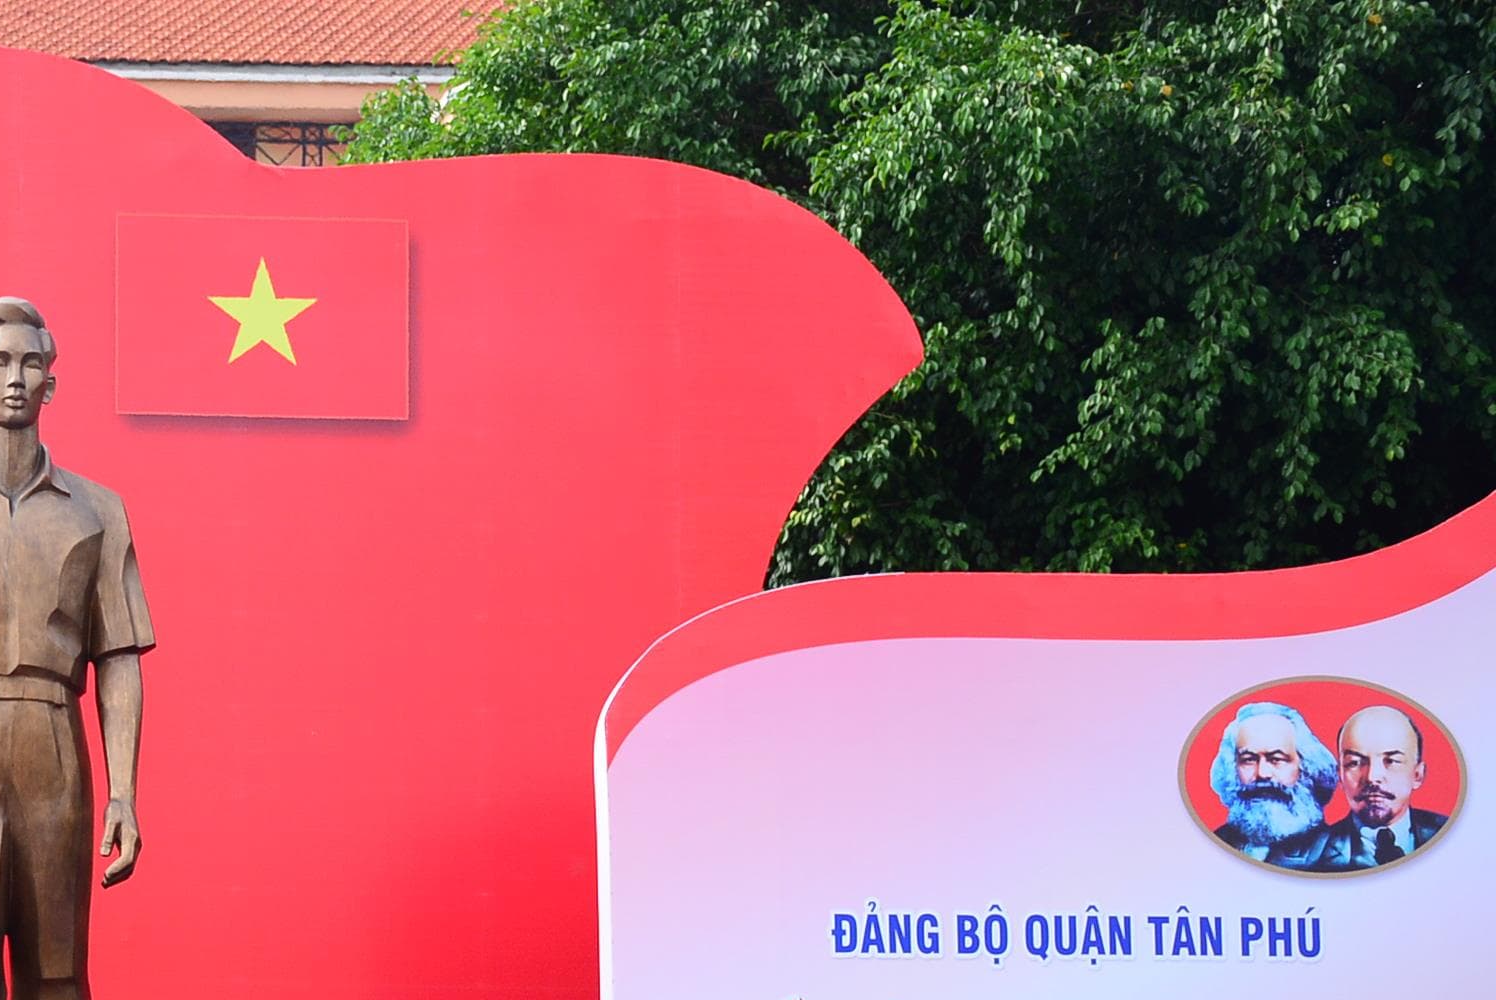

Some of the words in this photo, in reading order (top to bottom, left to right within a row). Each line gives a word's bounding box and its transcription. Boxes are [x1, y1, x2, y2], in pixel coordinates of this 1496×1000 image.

[832, 900, 940, 955] ĐẢNG
[956, 905, 1008, 964] BỘ
[1024, 906, 1133, 965] QUẬN
[1147, 906, 1223, 957] TÂN
[1240, 907, 1322, 959] PHÚ
